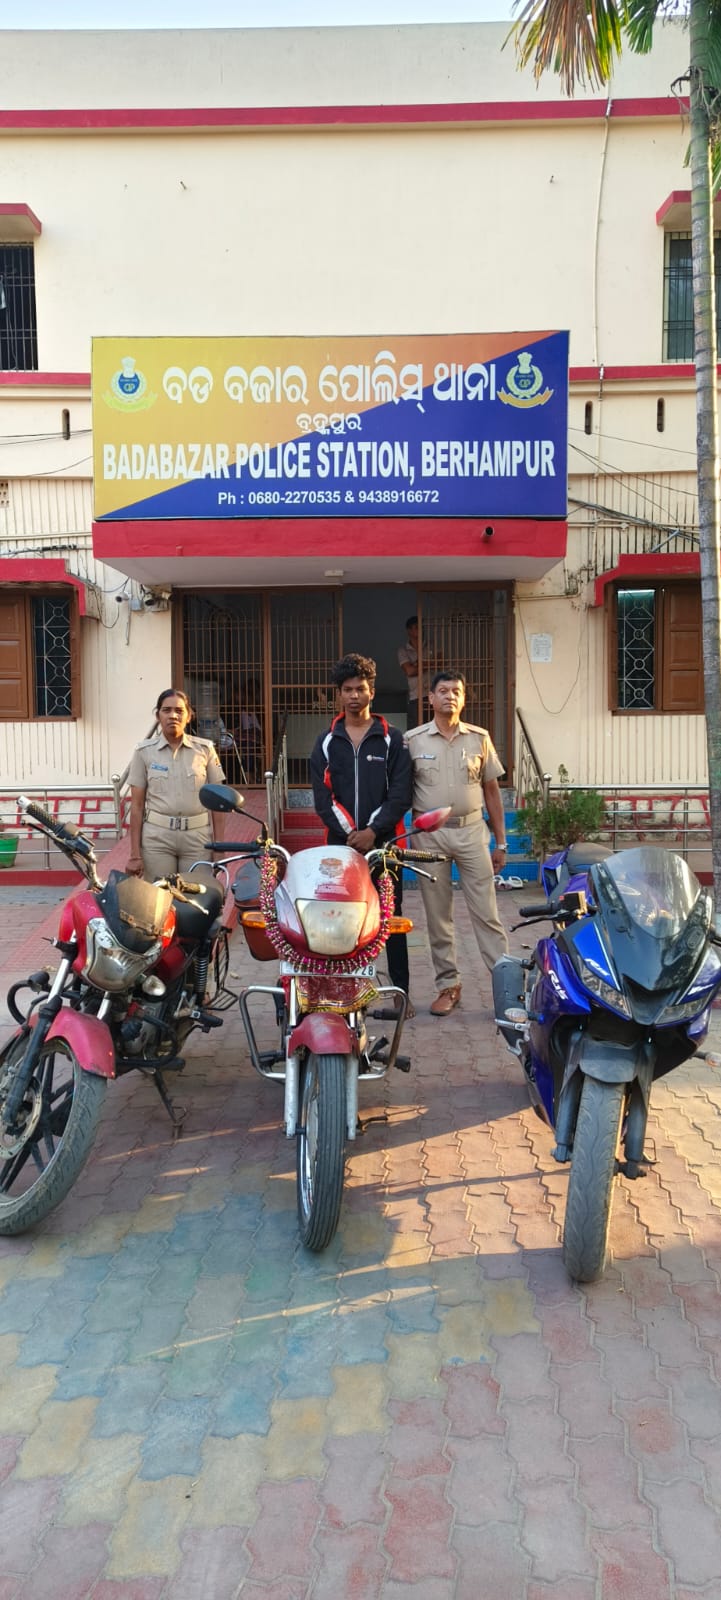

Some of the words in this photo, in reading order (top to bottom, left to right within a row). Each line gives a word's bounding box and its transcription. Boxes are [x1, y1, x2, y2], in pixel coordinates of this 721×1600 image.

[223, 365, 310, 406] ବଜାର
[318, 350, 425, 413] ପୋଲିସ୍
[432, 362, 496, 402] ଥାନା
[103, 443, 230, 480] BADABAZAR
[235, 442, 311, 479] POLICE
[316, 441, 415, 486] STATION,
[421, 440, 556, 478] BERHAMPUR
[217, 491, 236, 505] Ph
[248, 490, 341, 504] 0680-2270535
[344, 490, 355, 503] &
[358, 489, 440, 503] 9438916672
